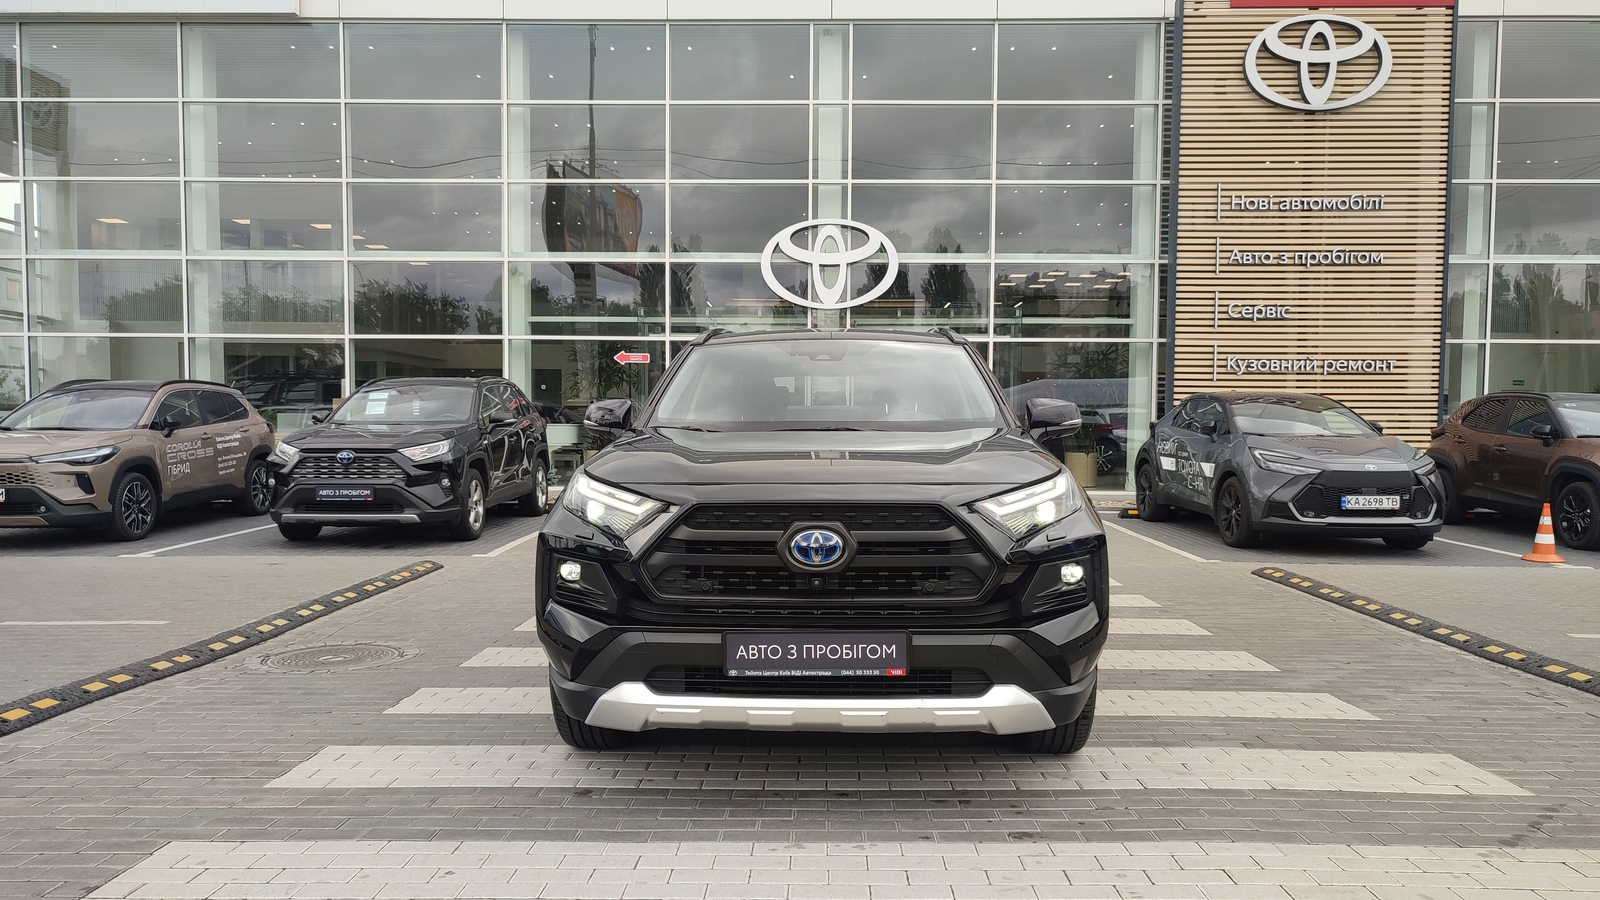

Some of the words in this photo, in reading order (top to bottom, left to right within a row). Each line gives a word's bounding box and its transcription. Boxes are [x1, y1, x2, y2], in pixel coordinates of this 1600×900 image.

[1230, 194, 1273, 210] Нові
[1279, 193, 1385, 210] автомобілі
[1228, 249, 1273, 265] Авто
[1277, 253, 1288, 265] з
[1294, 249, 1384, 268] пробігом
[1227, 302, 1291, 322] Сервіс
[1226, 356, 1317, 375] Кузовний
[1323, 358, 1396, 375] ремонт
[166, 440, 202, 452] COROLLA
[166, 447, 214, 463] CROSS
[167, 462, 191, 476] ГІБРИД
[1178, 458, 1201, 475] TOYOTA
[1187, 475, 1204, 491] C-HR
[736, 645, 782, 660] АВТО
[787, 645, 798, 660] З
[803, 644, 896, 659] ПРОБІГОМ
